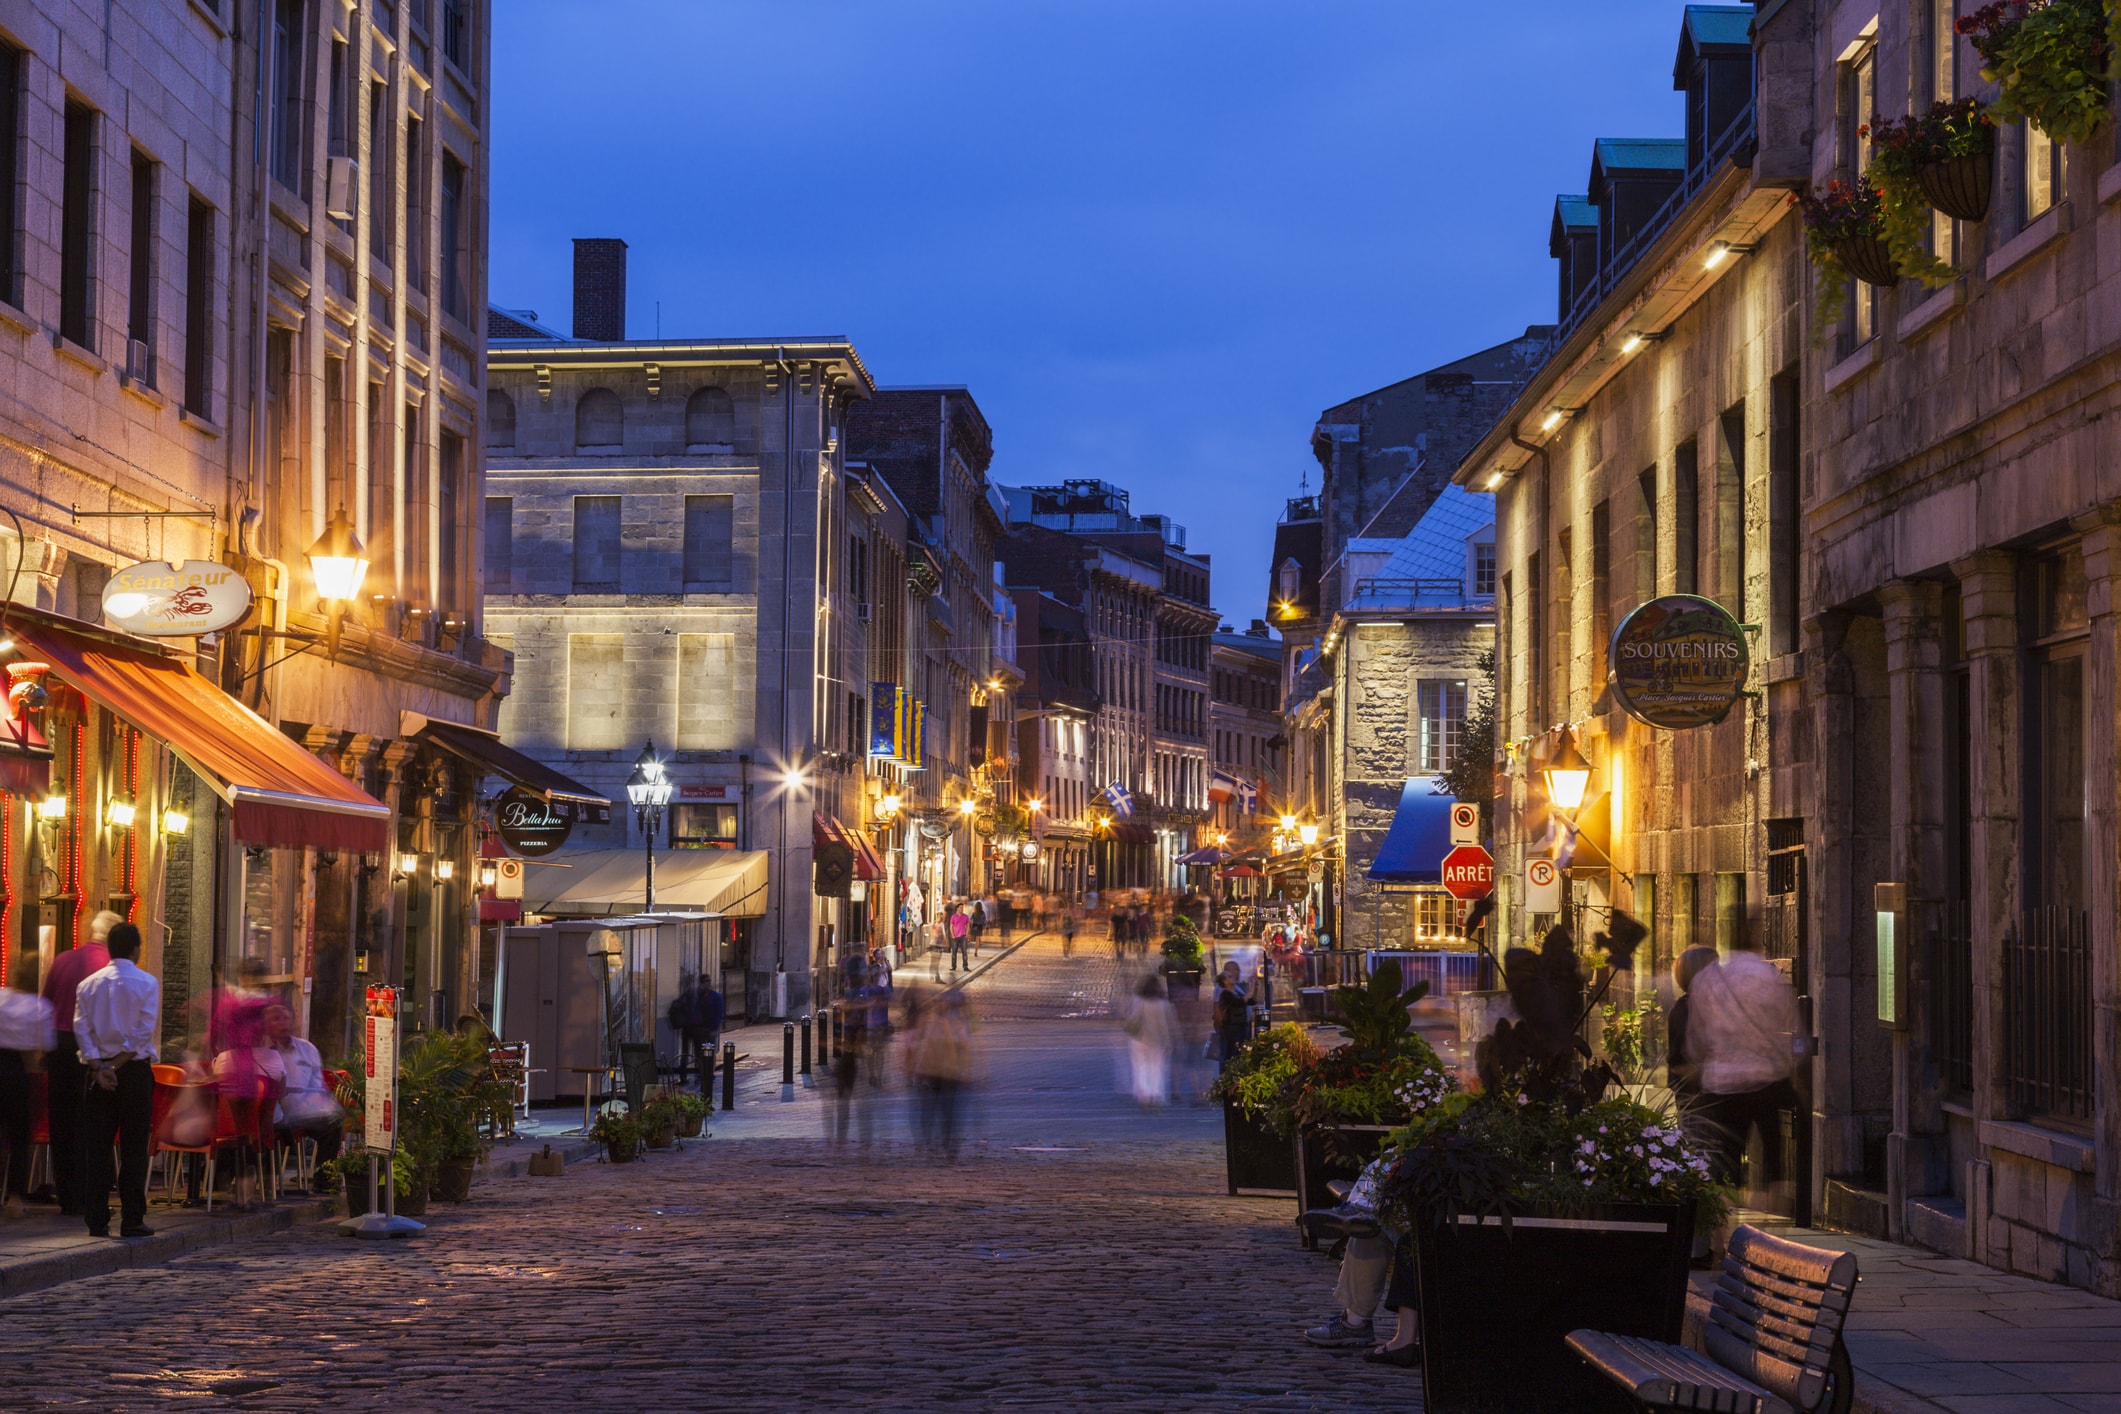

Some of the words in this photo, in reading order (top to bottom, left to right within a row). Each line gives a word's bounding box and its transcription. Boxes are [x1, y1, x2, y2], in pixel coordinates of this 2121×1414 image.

[117, 571, 232, 592] Sénateur
[1624, 642, 1739, 659] SOUVENIRS
[1636, 693, 1660, 701] Place
[1663, 693, 1696, 703] Jacques
[1698, 693, 1726, 701] Cartier
[501, 802, 542, 826] Bella
[1445, 864, 1494, 881] ARRÊT
